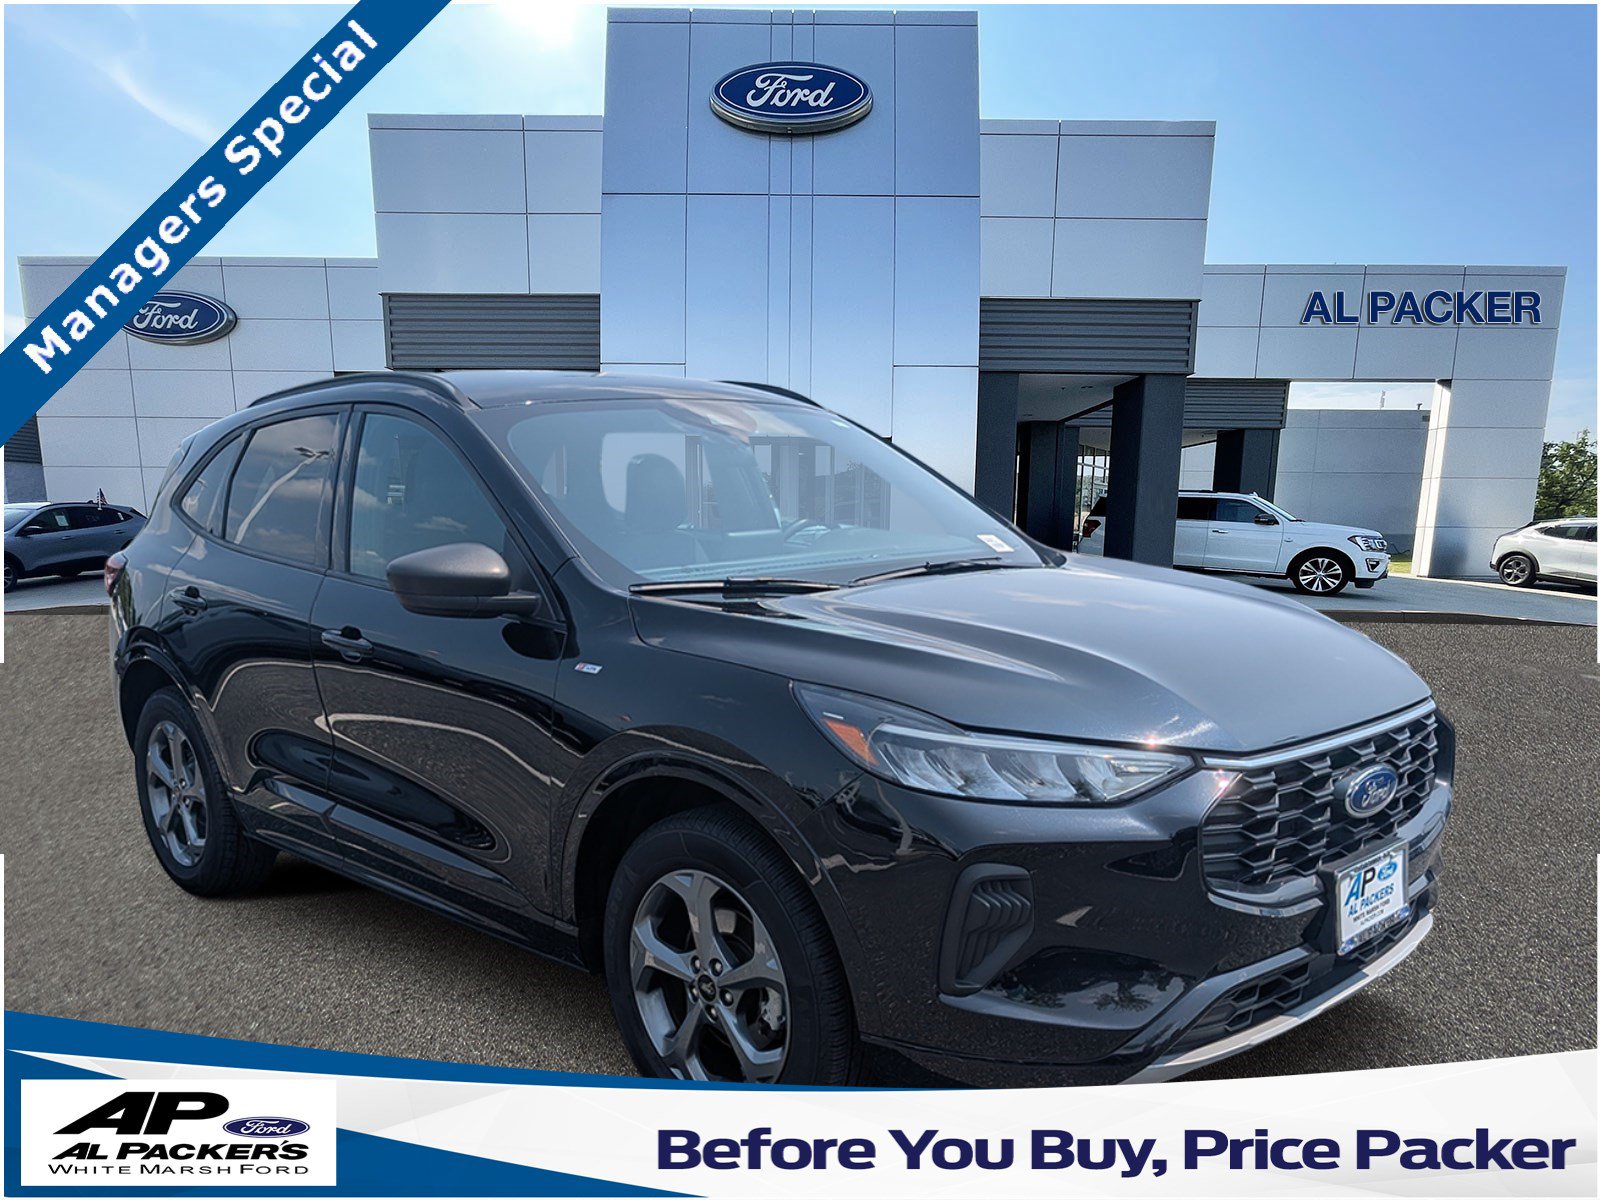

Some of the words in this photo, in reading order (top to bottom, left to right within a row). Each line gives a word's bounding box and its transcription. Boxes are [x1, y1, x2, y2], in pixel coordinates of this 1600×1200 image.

[746, 73, 836, 107] Ford
[132, 301, 199, 329] Ford
[1302, 290, 1359, 324] AL
[1369, 290, 1542, 324] PACKER
[1361, 776, 1391, 807] Ford
[1344, 866, 1376, 906] AP
